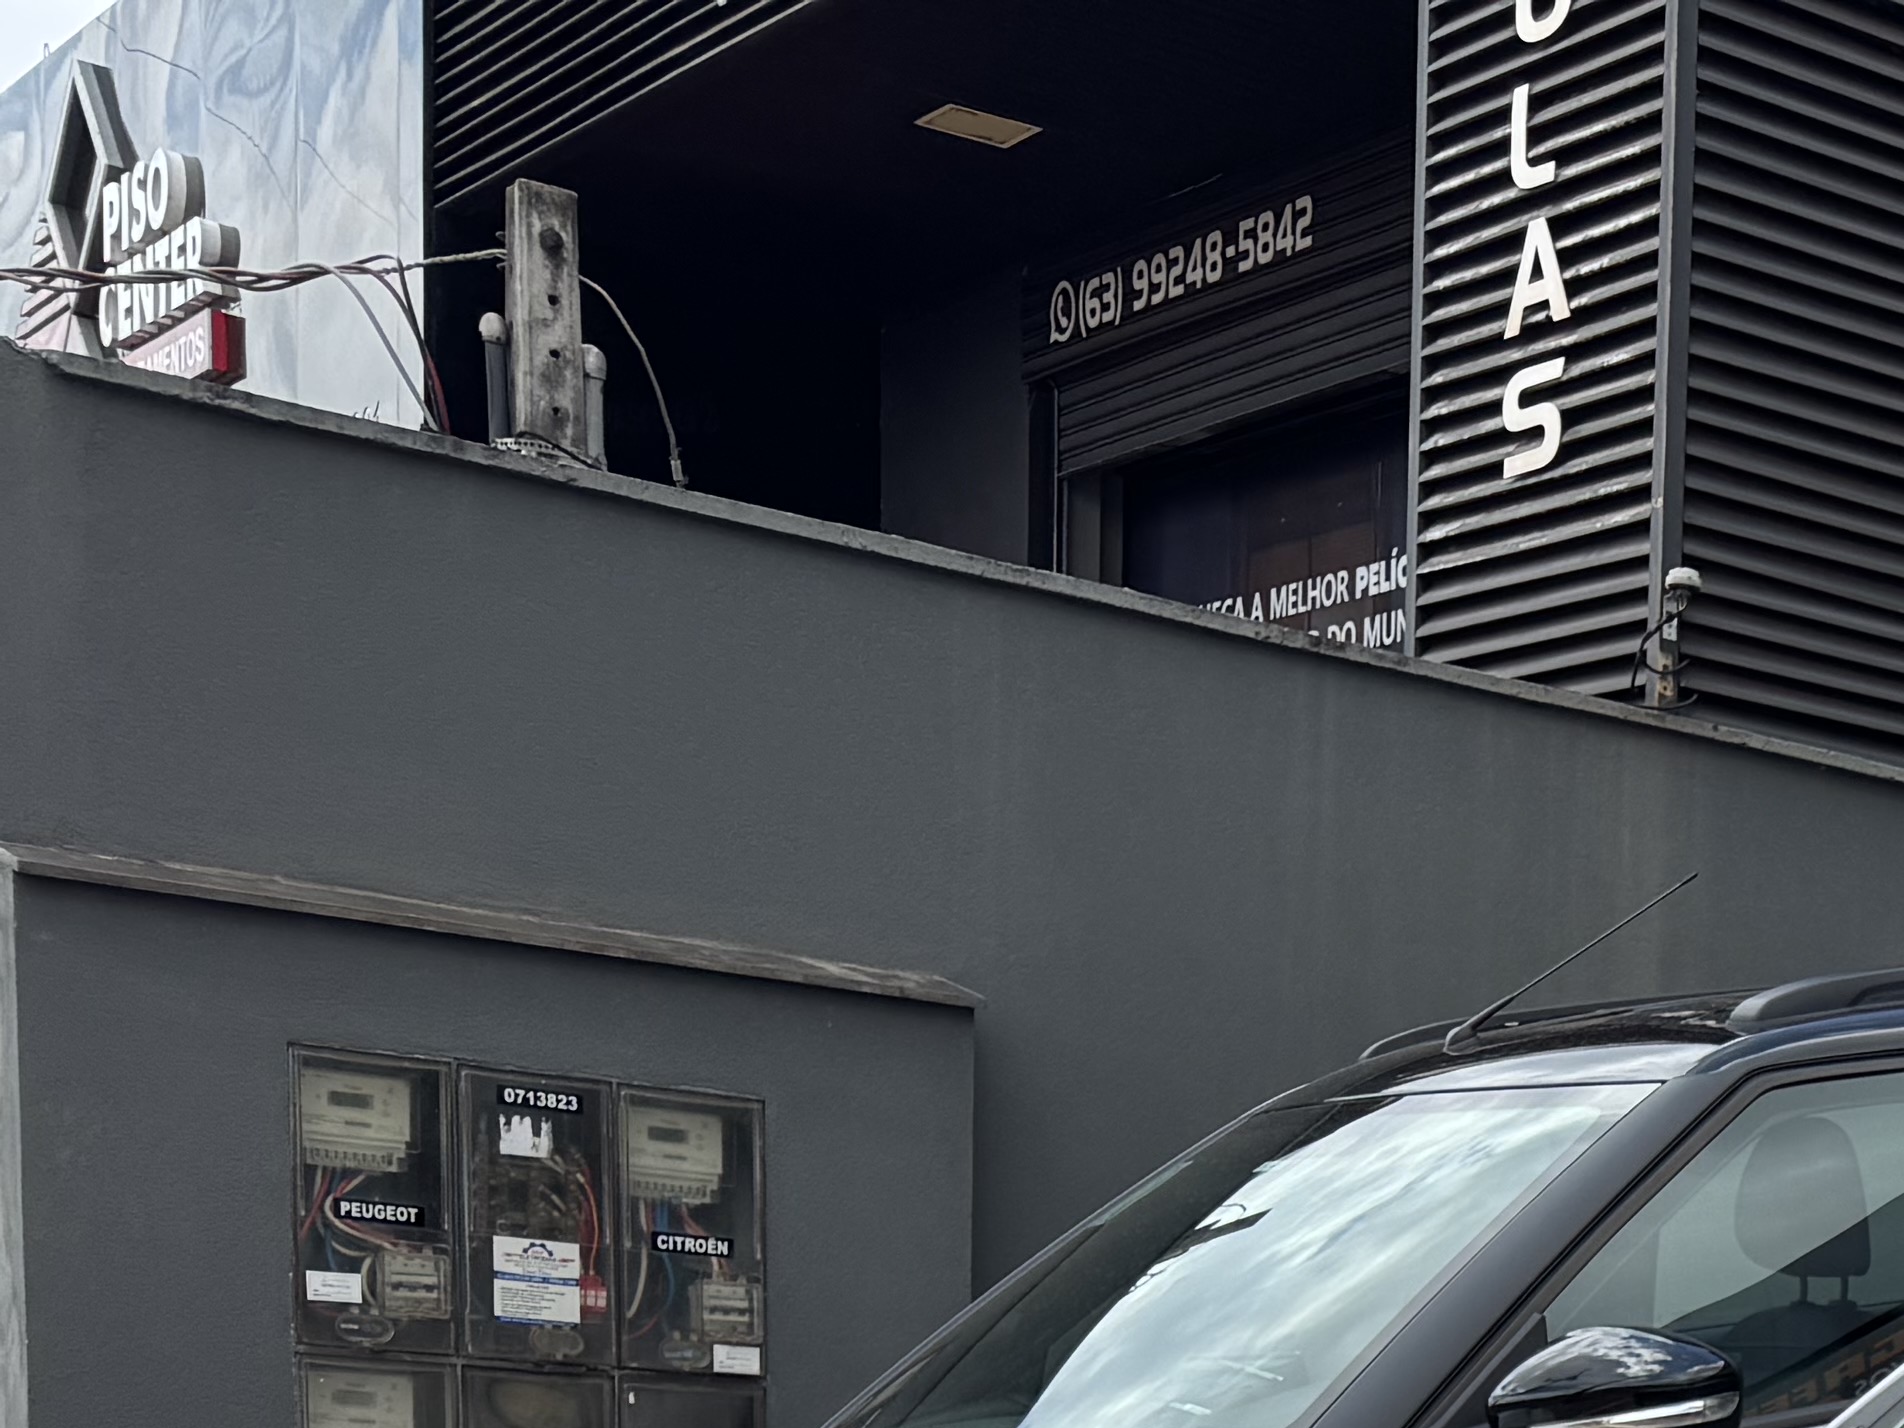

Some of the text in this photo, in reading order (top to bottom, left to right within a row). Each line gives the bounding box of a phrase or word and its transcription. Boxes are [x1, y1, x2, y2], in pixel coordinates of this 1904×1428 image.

[102, 147, 168, 263] PISO
[99, 216, 202, 348] CENTER
[1079, 195, 1313, 338] (63) 99248-5842
[1269, 570, 1349, 621] MELHOR
[503, 1087, 579, 1112] 0713823
[339, 1201, 419, 1223] PEUGEOT
